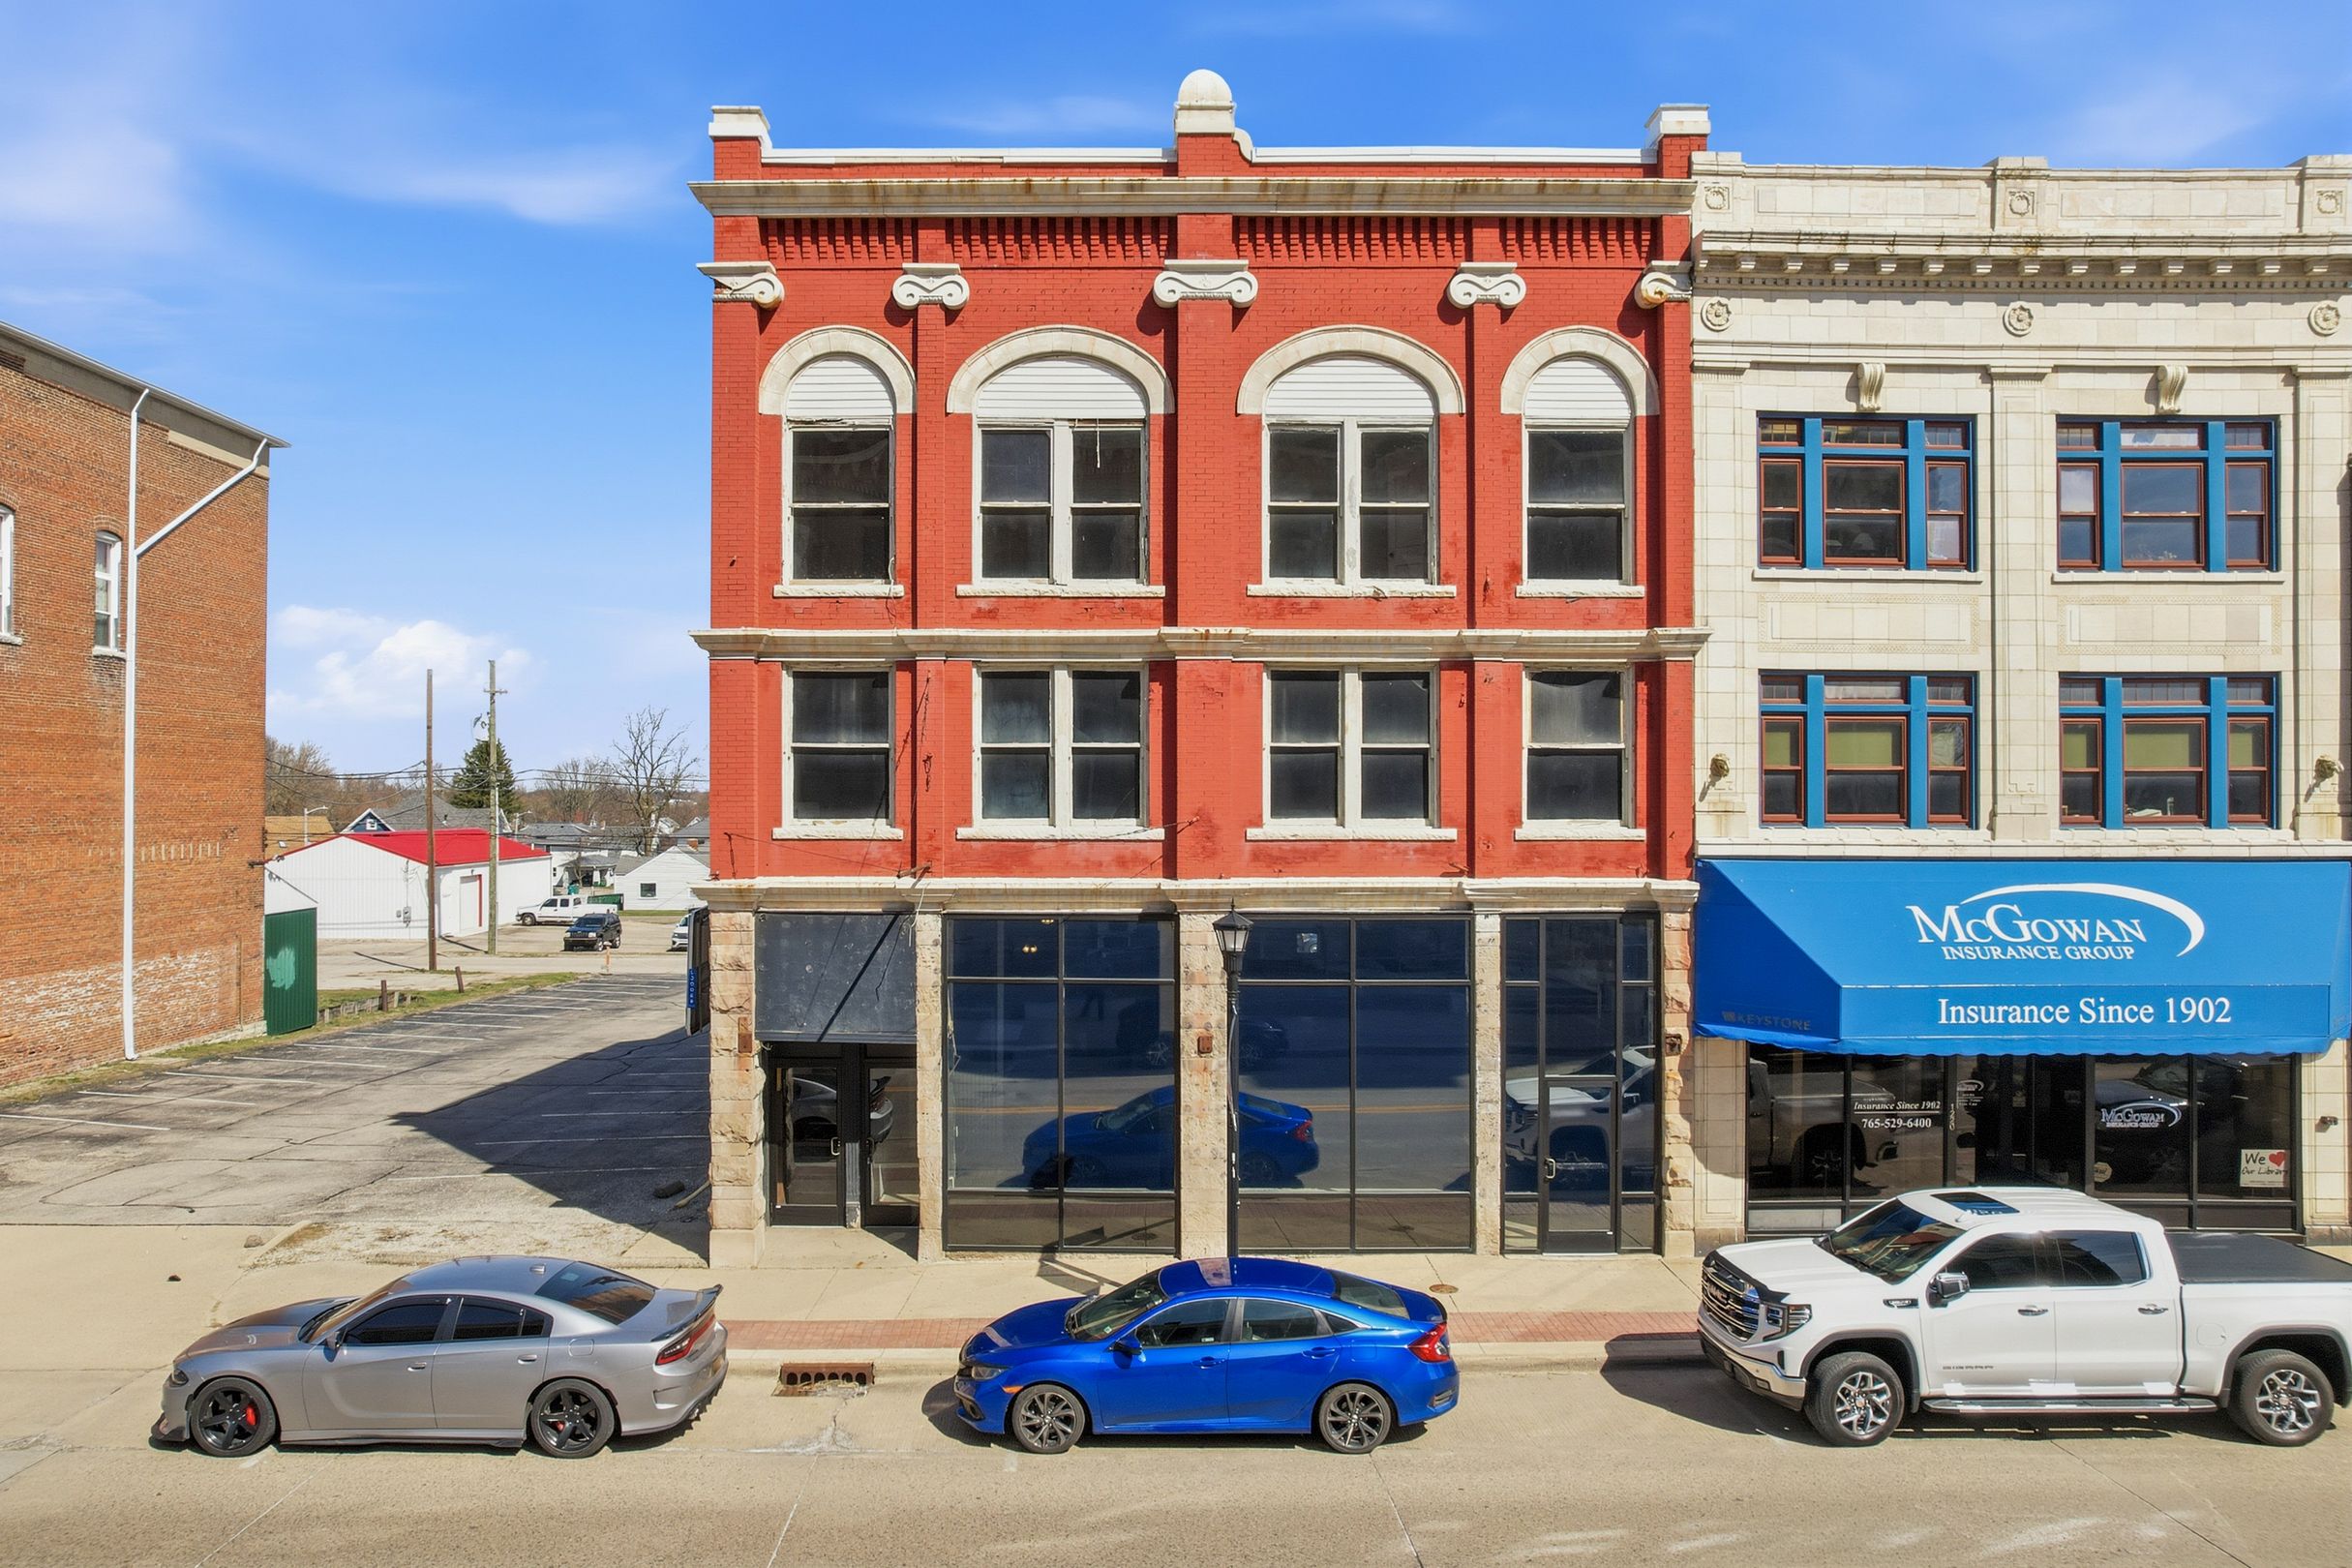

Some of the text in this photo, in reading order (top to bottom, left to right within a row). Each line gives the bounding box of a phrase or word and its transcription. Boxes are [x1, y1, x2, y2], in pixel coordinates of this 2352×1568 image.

[1941, 945, 2135, 960] INSURANCE GROUP
[1938, 997, 2232, 1024] Insurance Since 1902
[1854, 1101, 1941, 1110] Insurance Since 1902
[1861, 1117, 1933, 1129] 765-529-6400
[2245, 1152, 2266, 1165] We
